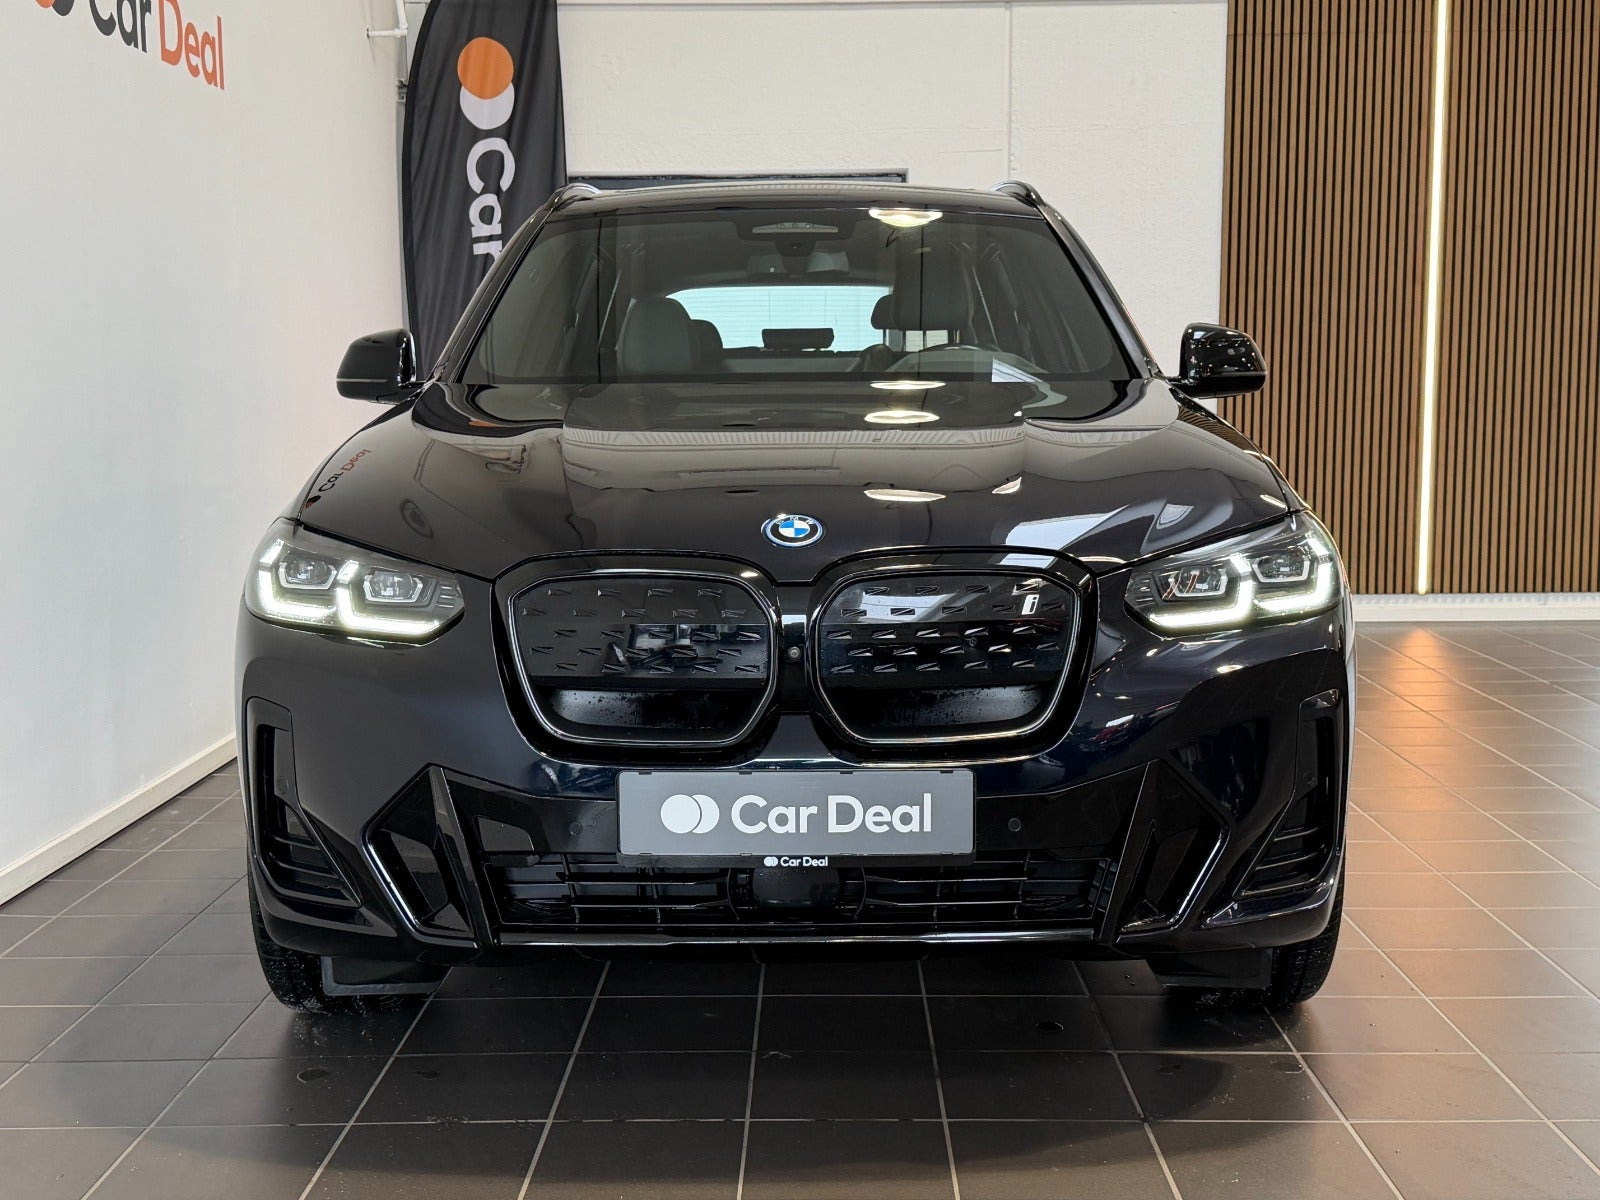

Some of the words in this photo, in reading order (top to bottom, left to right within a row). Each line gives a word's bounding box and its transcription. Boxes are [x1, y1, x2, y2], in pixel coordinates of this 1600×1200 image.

[158, 0, 225, 90] Deal
[466, 137, 516, 262] Car
[731, 794, 818, 834] Car
[828, 793, 932, 833] Deal
[780, 856, 802, 867] Car
[802, 856, 829, 867] Deal
